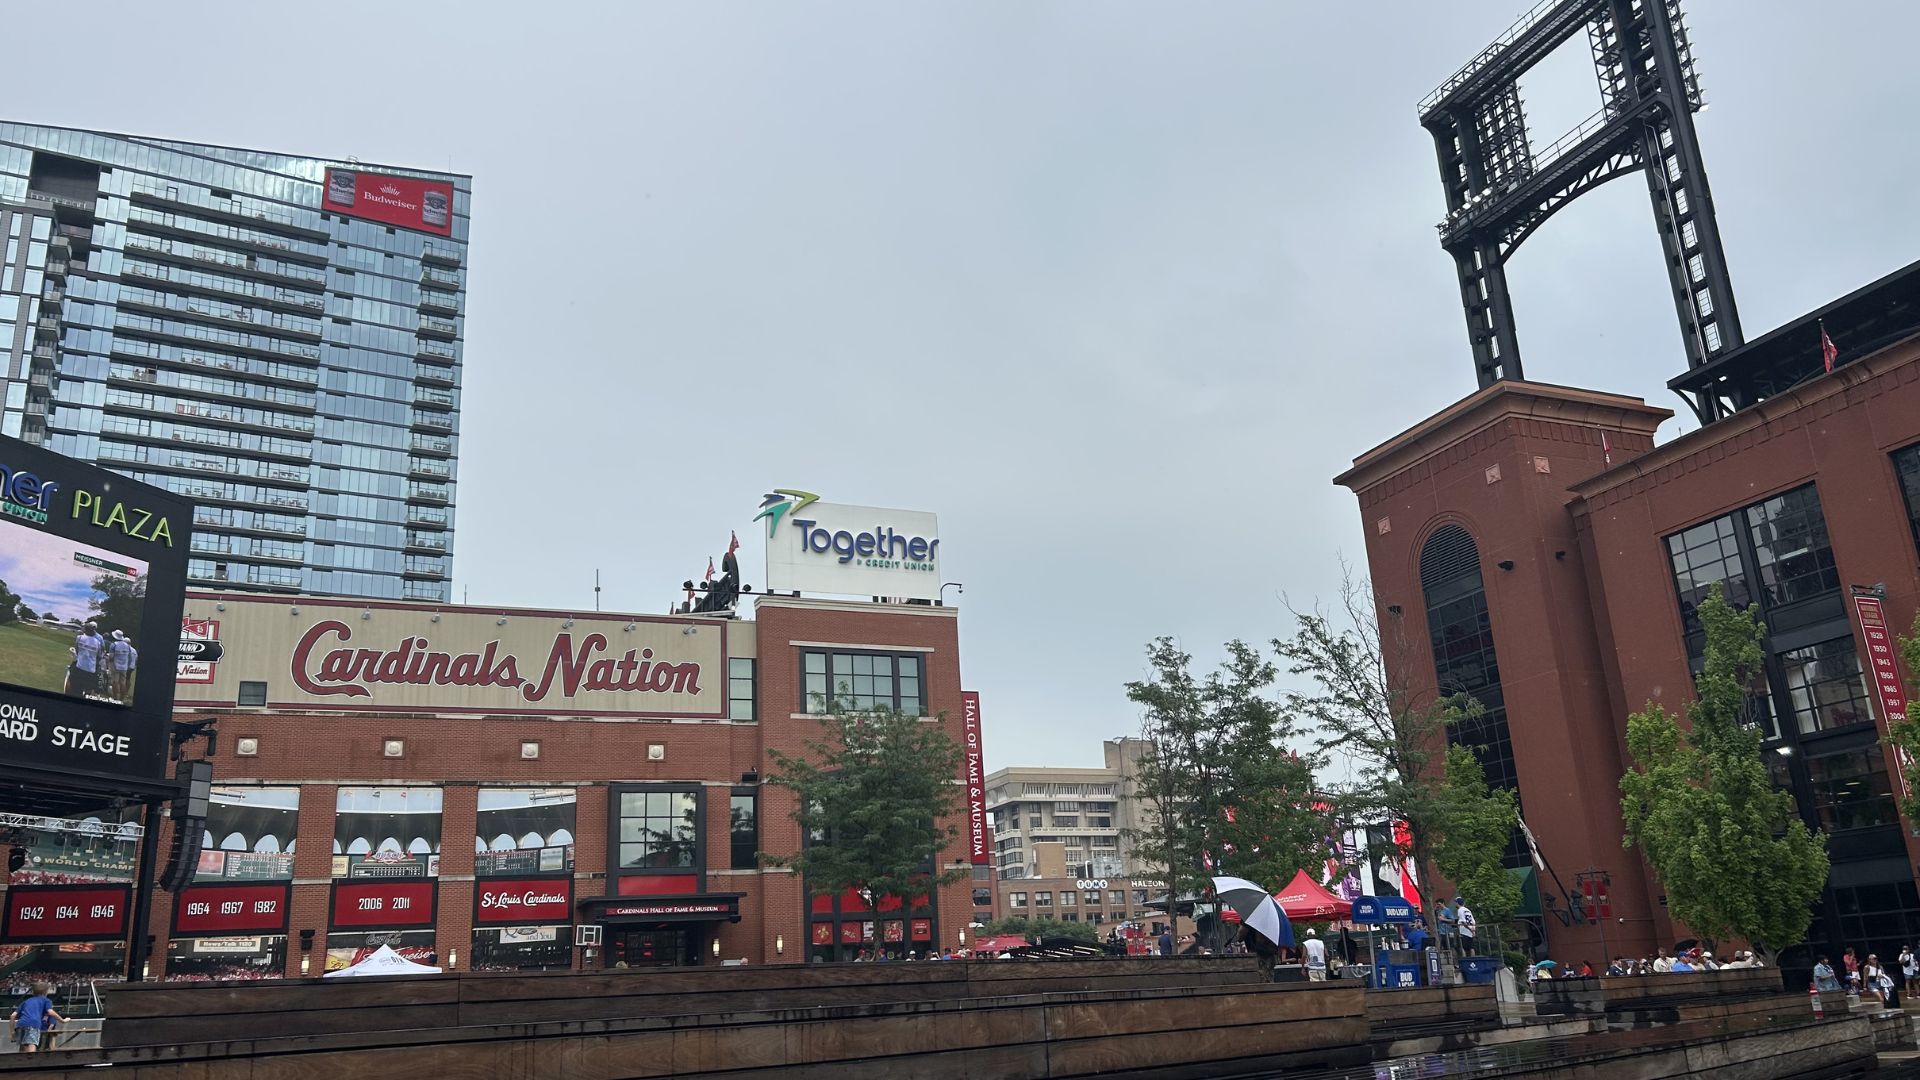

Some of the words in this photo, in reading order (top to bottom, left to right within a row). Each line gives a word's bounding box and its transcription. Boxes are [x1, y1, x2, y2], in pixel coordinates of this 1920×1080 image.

[363, 191, 418, 210] Budweiser
[2, 501, 48, 523] UNION
[72, 489, 173, 548] PLAZA
[792, 519, 940, 563] Together
[75, 553, 103, 567] MEISSNER
[865, 558, 901, 569] CREDIT
[904, 562, 935, 572] UNION
[291, 620, 527, 699] Cardinals
[522, 632, 703, 702] Nation
[179, 664, 209, 676] Nation
[0, 704, 39, 722] ONAL
[965, 699, 976, 730] HALL
[51, 725, 131, 756] STAGE
[967, 732, 977, 749] OF
[968, 752, 979, 784] FAME
[970, 787, 981, 798] &
[971, 800, 984, 856] MUSEUM
[44, 857, 88, 867] WORLD
[1077, 879, 1108, 889] TUMS
[1131, 880, 1165, 888] HALEON
[187, 902, 210, 915] 1964
[221, 901, 244, 914] 1967
[254, 900, 277, 913] 1982
[358, 897, 383, 910] 2006
[392, 896, 410, 909] 2011
[494, 892, 521, 909] Louis
[523, 890, 566, 907] Cardinals
[20, 906, 45, 920] 1942
[55, 905, 80, 919] 1944
[90, 904, 115, 918] 1946
[695, 905, 719, 913] MUSEUM
[1385, 908, 1397, 916] BUD
[1396, 908, 1409, 916] LIGHT
[1399, 971, 1413, 982] BUD
